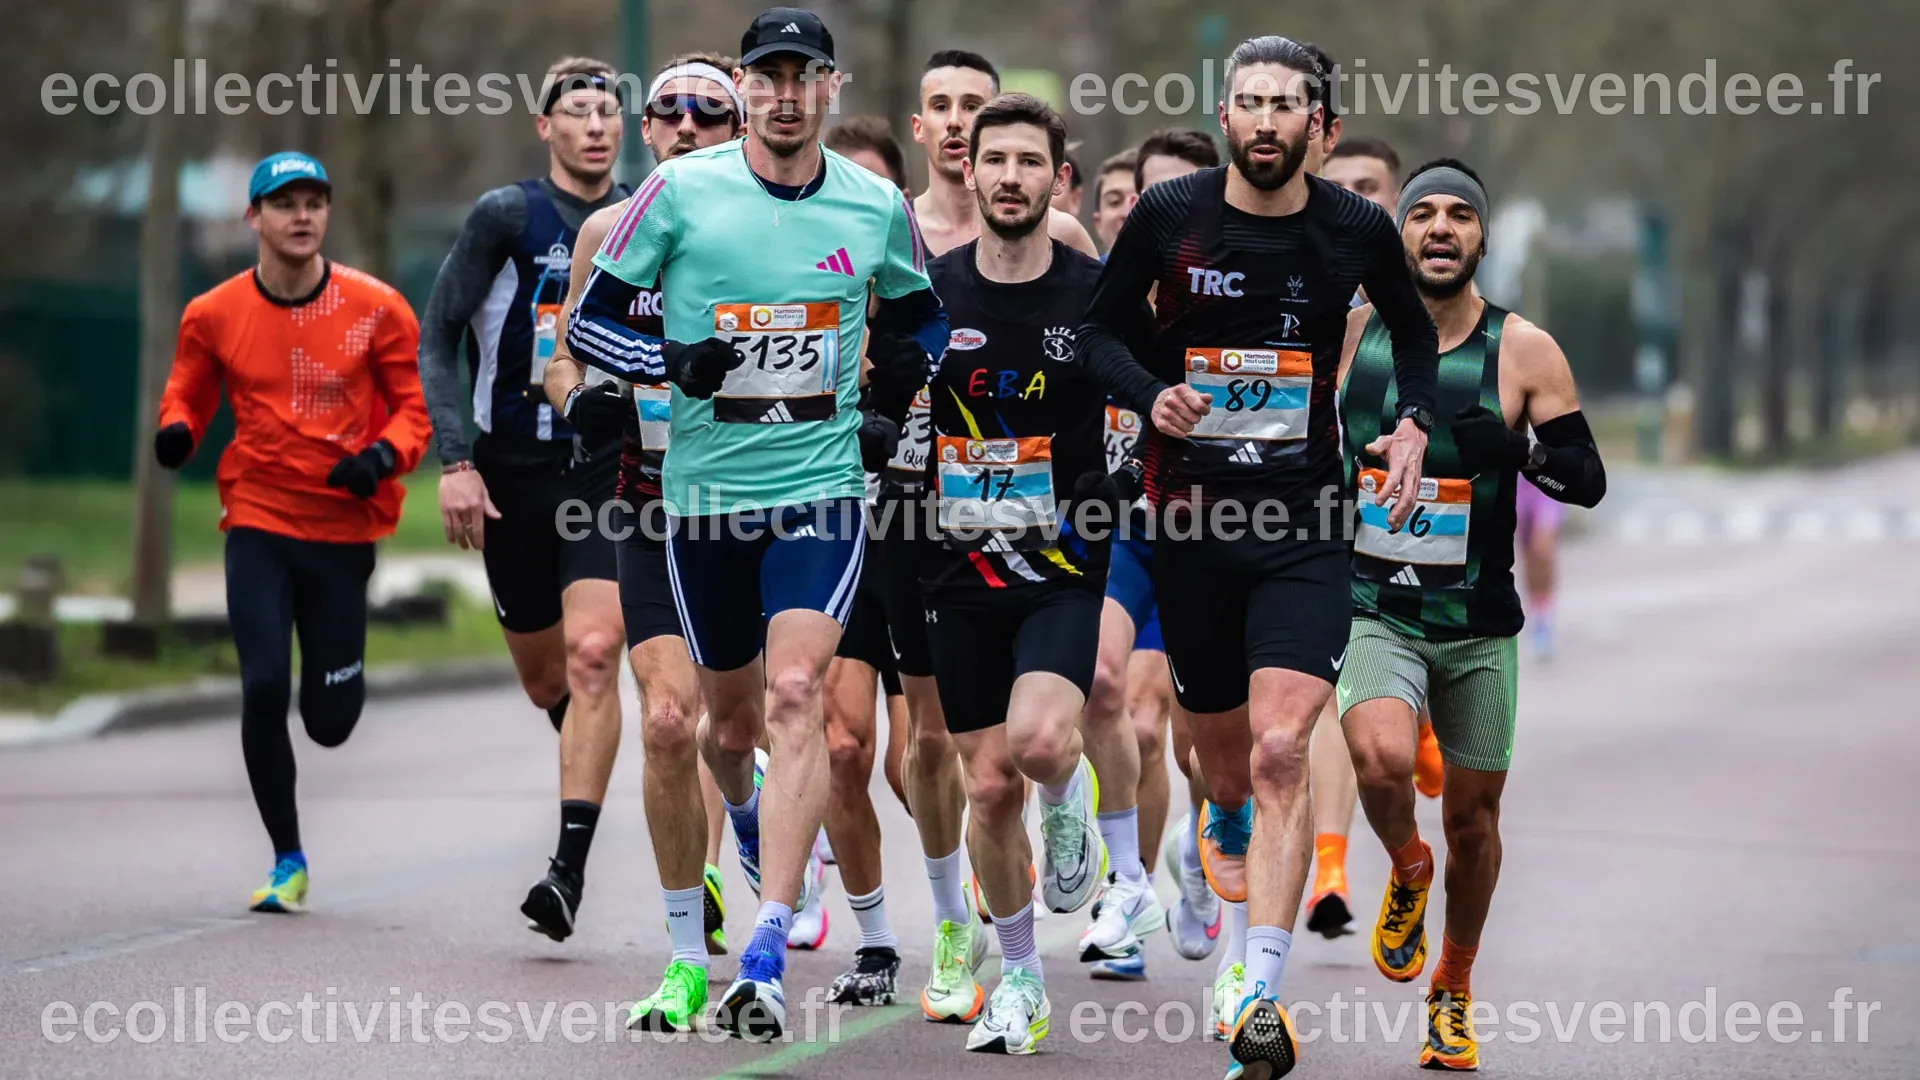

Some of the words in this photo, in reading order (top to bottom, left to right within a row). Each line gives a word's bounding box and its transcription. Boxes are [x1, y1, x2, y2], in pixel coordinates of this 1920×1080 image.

[1187, 266, 1246, 298] TRC
[728, 334, 824, 372] 5135
[968, 368, 1046, 400] E.B.A
[1225, 378, 1272, 412] 89
[973, 467, 1016, 502] 17
[1535, 474, 1566, 492] KIPRUN
[669, 910, 689, 918] RUN
[1262, 947, 1281, 958] RUN
